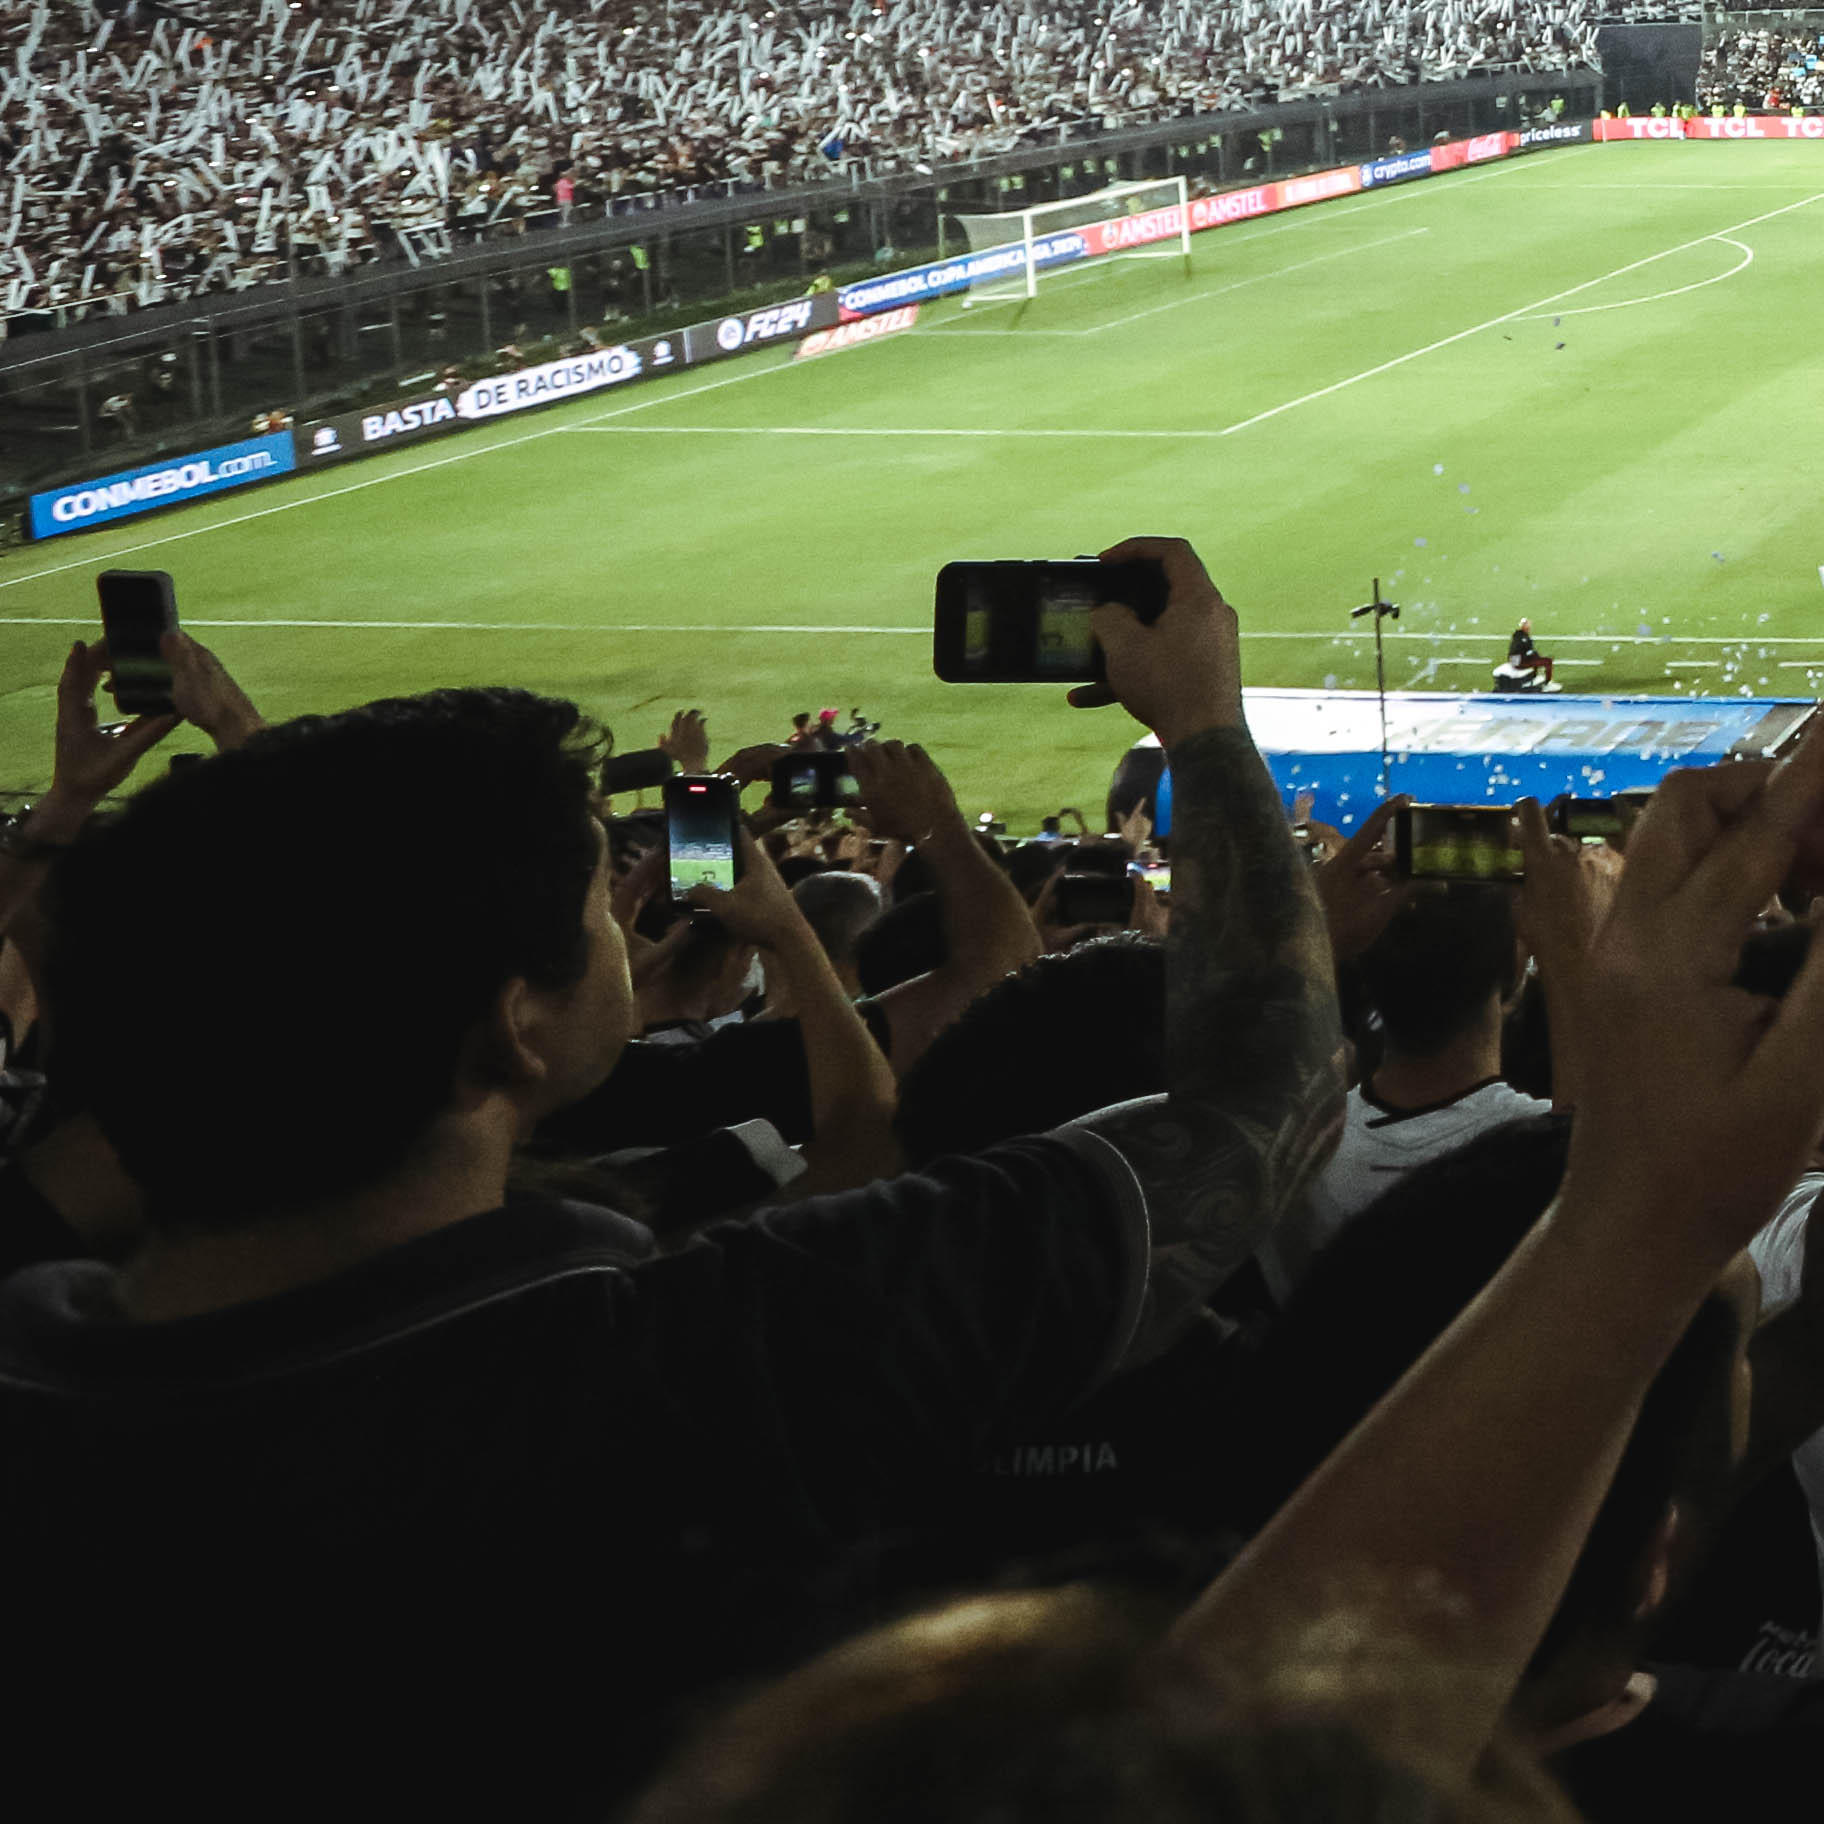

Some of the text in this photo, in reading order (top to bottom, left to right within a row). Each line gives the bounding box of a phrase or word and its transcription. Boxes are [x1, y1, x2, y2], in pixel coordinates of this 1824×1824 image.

[1520, 124, 1582, 147] priceless
[1628, 118, 1683, 137] TCL
[1704, 117, 1764, 137] TCL
[1373, 154, 1431, 179] crypto.com
[1207, 189, 1266, 221] AMSTEL
[1118, 209, 1181, 243] AMSTEL
[828, 306, 917, 349] AMSTEL
[362, 354, 624, 442] BASTA DE RACISMO
